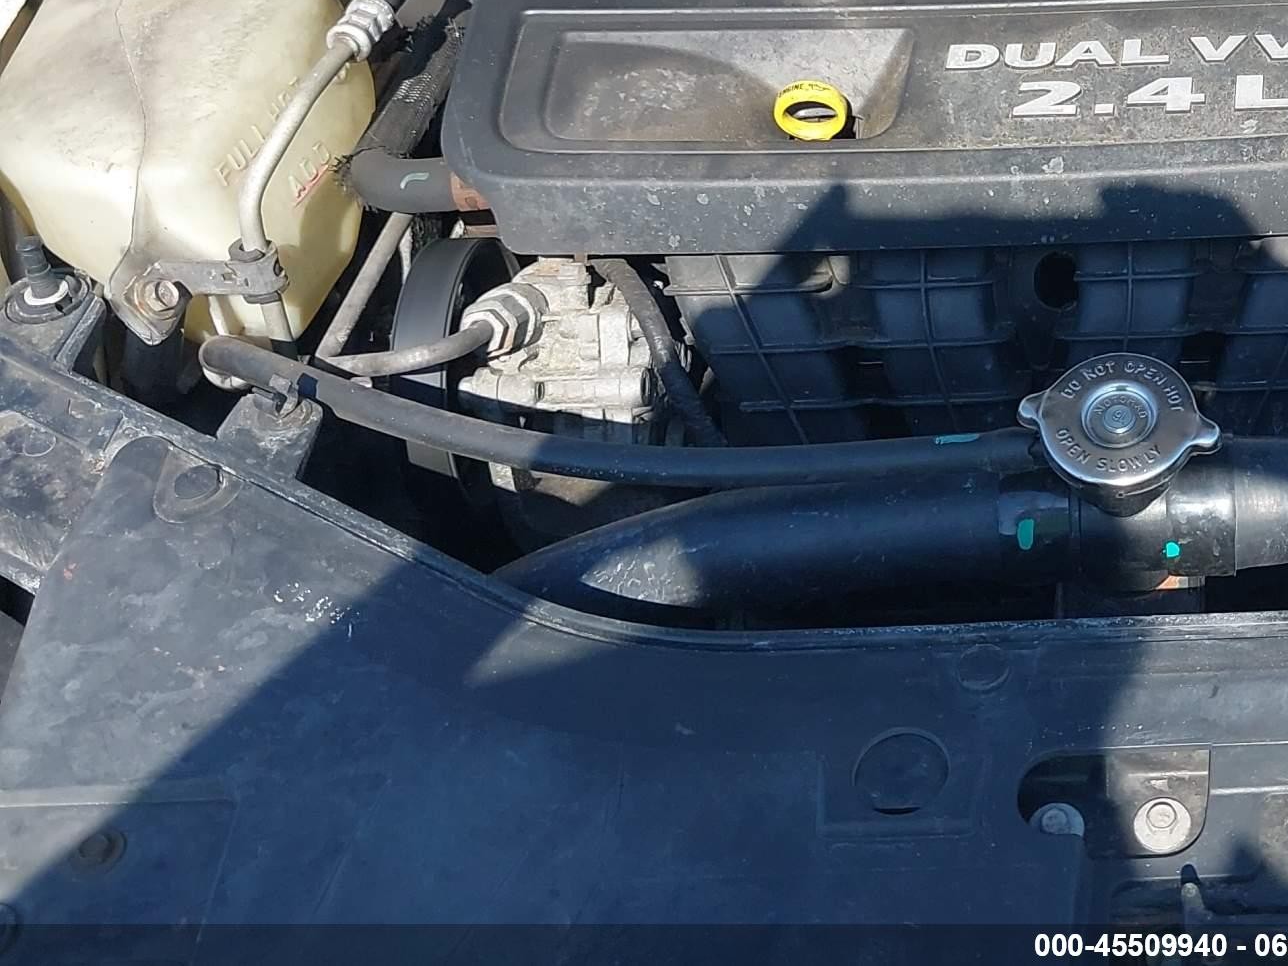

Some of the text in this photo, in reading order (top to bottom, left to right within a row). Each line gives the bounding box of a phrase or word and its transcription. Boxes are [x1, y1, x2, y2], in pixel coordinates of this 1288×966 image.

[945, 38, 1170, 69] DUAL
[288, 142, 331, 199] ADD
[1060, 360, 1186, 413] DO NOT OPEN HOT
[1055, 428, 1162, 473] OPEN SLOWLY
